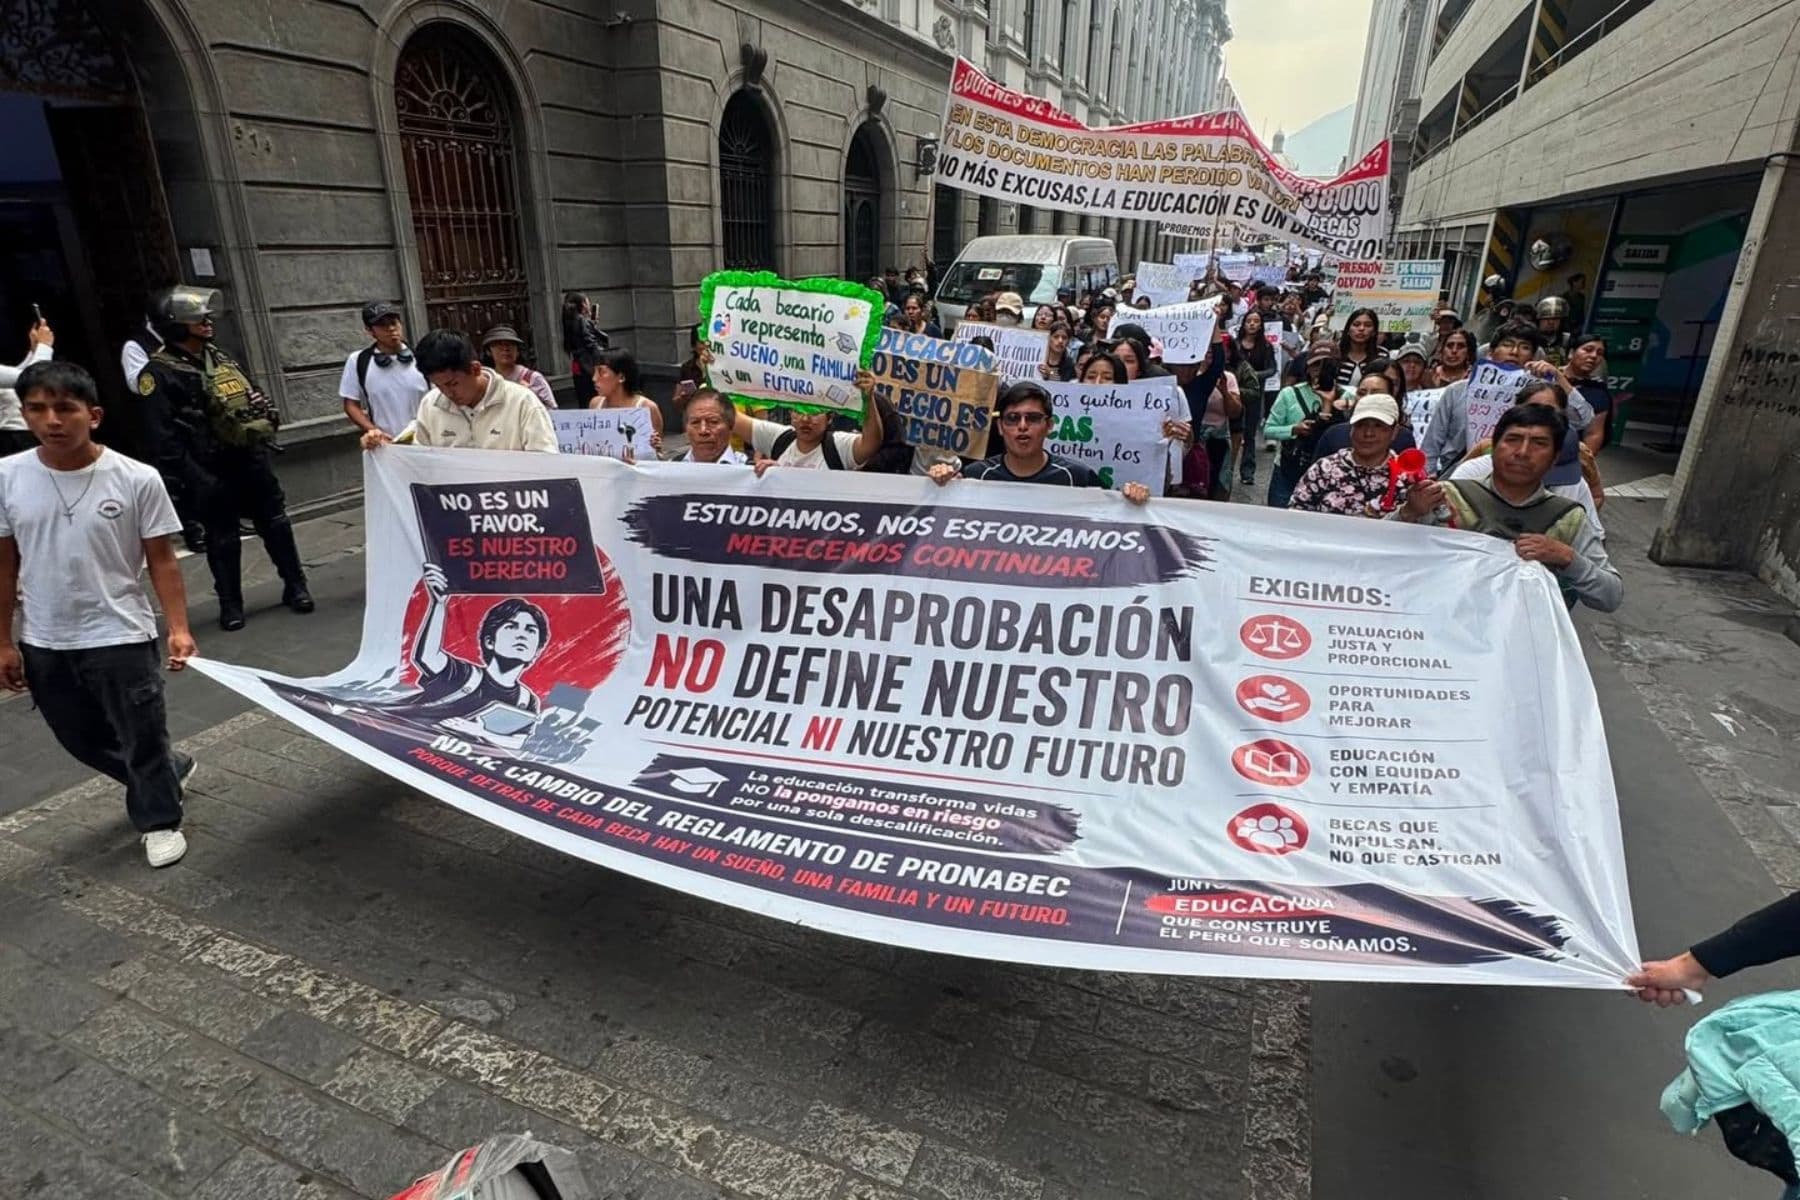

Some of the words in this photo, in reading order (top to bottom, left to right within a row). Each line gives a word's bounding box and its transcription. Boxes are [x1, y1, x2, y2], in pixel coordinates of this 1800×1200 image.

[950, 103, 972, 127] EN
[973, 110, 1013, 140] ESTA
[1017, 124, 1137, 160] DEMOCRACIA
[1141, 142, 1178, 161] LAS
[953, 129, 985, 155] LOS
[987, 140, 1112, 180] DOCUMENTOS
[1116, 163, 1156, 182] HAN
[1159, 166, 1242, 187] PERDIDO
[938, 153, 959, 177] NO
[960, 160, 998, 188] MÁS
[1121, 189, 1231, 217] EDUCACIÓN
[1233, 195, 1260, 219] ES
[1261, 203, 1287, 229] UN
[1159, 222, 1211, 237] APROBEMOS
[1338, 261, 1383, 275] PRESIÓN
[1337, 277, 1376, 289] OLVIDO
[725, 289, 761, 313] Cada
[775, 291, 835, 324] becario
[741, 317, 826, 348] representa
[1160, 321, 1189, 333] LOS
[875, 328, 993, 374] DUCACION
[811, 354, 858, 381] FAMILIA
[872, 352, 888, 376] O
[890, 355, 920, 384] ES
[925, 362, 961, 393] UN
[721, 369, 733, 385] y
[735, 369, 752, 384] un
[763, 371, 814, 396] FUTURO
[1053, 393, 1070, 408] os
[1080, 389, 1132, 415] quitan
[1144, 392, 1171, 412] las
[956, 402, 989, 431] ES
[1112, 442, 1141, 464] los
[439, 492, 472, 511] NO
[478, 492, 509, 510] ES
[515, 489, 549, 509] UN
[470, 513, 546, 534] FAVOR,
[683, 502, 866, 536] ESTUDIAMOS,
[876, 515, 936, 536] NOS
[943, 518, 1147, 554] ESFORZAMOS,
[448, 537, 474, 556] ES
[482, 536, 578, 556] NUESTRO
[726, 533, 904, 564] MERECEMOS
[912, 543, 1099, 579] CONTINUAR.
[469, 560, 567, 580] DERECHO
[1249, 576, 1392, 607] EXIGIMOS:
[652, 572, 743, 630] UNA
[760, 582, 1194, 662] DESAPROBACIÓN
[1328, 625, 1425, 641] EVALUACIÓN
[1328, 639, 1377, 652] JUSTA
[1381, 642, 1393, 652] Y
[1328, 653, 1453, 669] PROPORCIONAL
[644, 633, 727, 694] NO
[733, 642, 912, 714] DEFINE
[921, 659, 1194, 737] NUESTRO
[1329, 684, 1471, 701] OPORTUNIDADES
[1329, 700, 1375, 712] PARA
[1329, 715, 1412, 729] MEJORAR
[624, 694, 792, 747] POTENCIAL
[800, 715, 844, 751] NI
[846, 719, 1015, 771] NUESTRO
[1023, 735, 1187, 788] FUTURO
[1330, 749, 1435, 764] EDUCACIÓN
[1329, 765, 1368, 778] CON
[1375, 765, 1461, 780] EQUIDAD
[748, 770, 769, 782] La
[773, 775, 865, 796] educación
[869, 787, 977, 812] transforma
[983, 801, 1039, 820] vidas
[1329, 782, 1341, 794] Y
[1349, 780, 1433, 797] EMPATÍA
[740, 783, 770, 795] NO
[773, 785, 791, 799] la
[792, 789, 900, 816] pongamos
[903, 804, 930, 820] en
[934, 807, 1001, 833] riesgo
[504, 764, 604, 806] CAMBIO
[602, 796, 655, 823] DEL
[656, 811, 847, 865] REGLAMENTO
[849, 849, 894, 875] DE
[897, 856, 1071, 898] PRONABEC
[730, 796, 764, 809] por
[766, 802, 801, 816] una
[804, 807, 844, 822] sola
[849, 812, 1005, 847] descalificación.
[1330, 818, 1392, 833] BECAS
[1399, 819, 1440, 834] QUE
[407, 747, 471, 779] PORQUE
[470, 773, 536, 805] DETRÁS
[530, 799, 555, 814] DE
[556, 805, 605, 830] CADA
[604, 822, 652, 845] BECA
[652, 836, 692, 855] HAY
[691, 846, 722, 864] UN
[721, 852, 786, 881] SUEÑO,
[791, 868, 834, 890] UNA
[836, 878, 917, 907] FAMILIA
[926, 892, 941, 907] Y
[942, 895, 978, 915] UN
[978, 899, 1073, 927] FUTURO.
[1329, 833, 1443, 851] IMPULSAN,
[1329, 850, 1354, 864] NO
[1361, 851, 1398, 866] QUE
[1403, 851, 1503, 867] CASTIGAN
[1162, 915, 1203, 927] QUE
[1207, 917, 1332, 935] CONSTRUYE
[1159, 927, 1182, 939] EL
[1188, 929, 1243, 944] PERÚ
[1248, 935, 1291, 948] QUE
[1298, 935, 1419, 953] SOÑAMOS.
